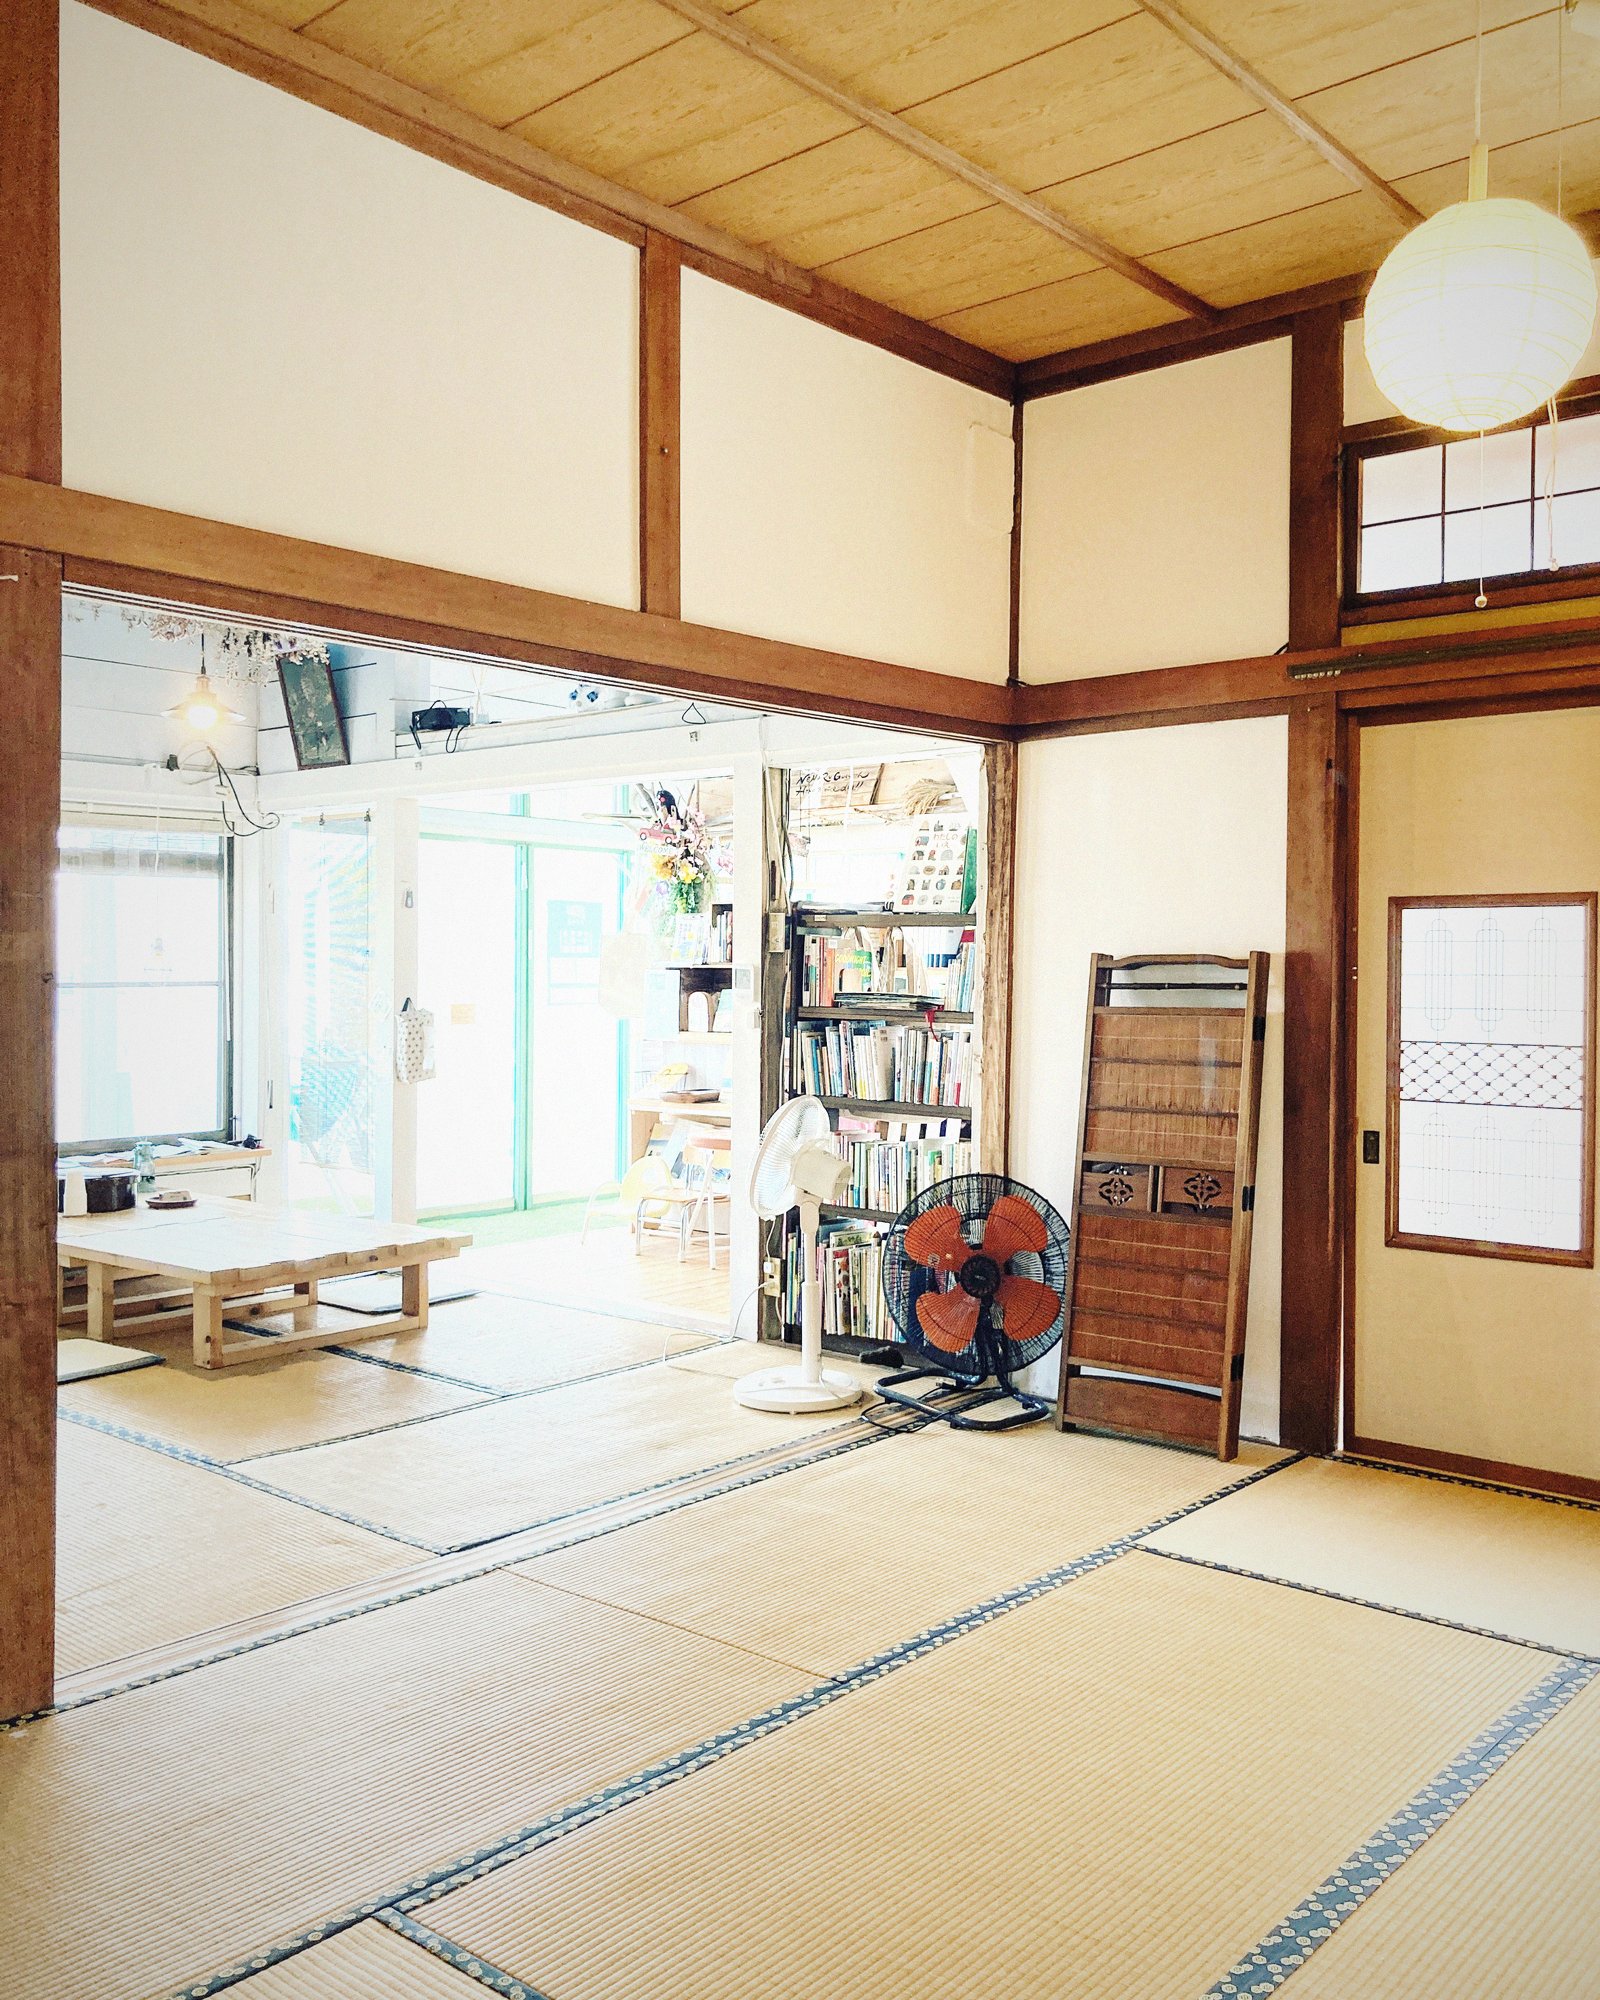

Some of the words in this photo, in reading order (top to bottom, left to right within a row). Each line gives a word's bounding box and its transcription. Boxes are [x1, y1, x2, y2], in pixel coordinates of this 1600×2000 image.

[933, 832, 959, 841] わたしの
[935, 840, 951, 849] いえ
